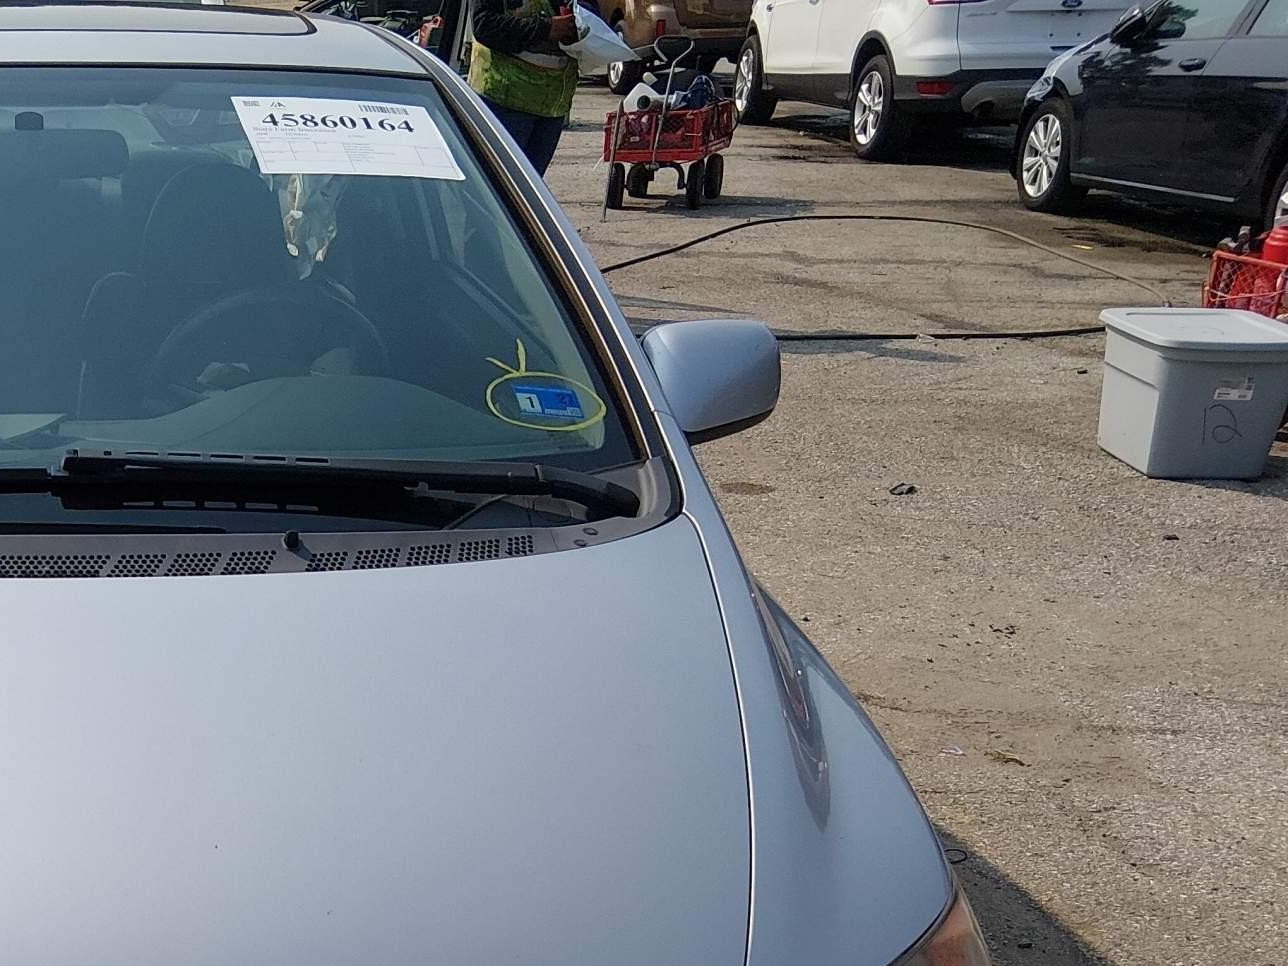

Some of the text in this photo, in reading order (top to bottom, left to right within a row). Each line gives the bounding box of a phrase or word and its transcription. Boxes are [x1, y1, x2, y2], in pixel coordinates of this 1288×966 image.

[262, 112, 414, 133] 45860164
[525, 396, 535, 408] 1
[1202, 403, 1243, 445] 12
